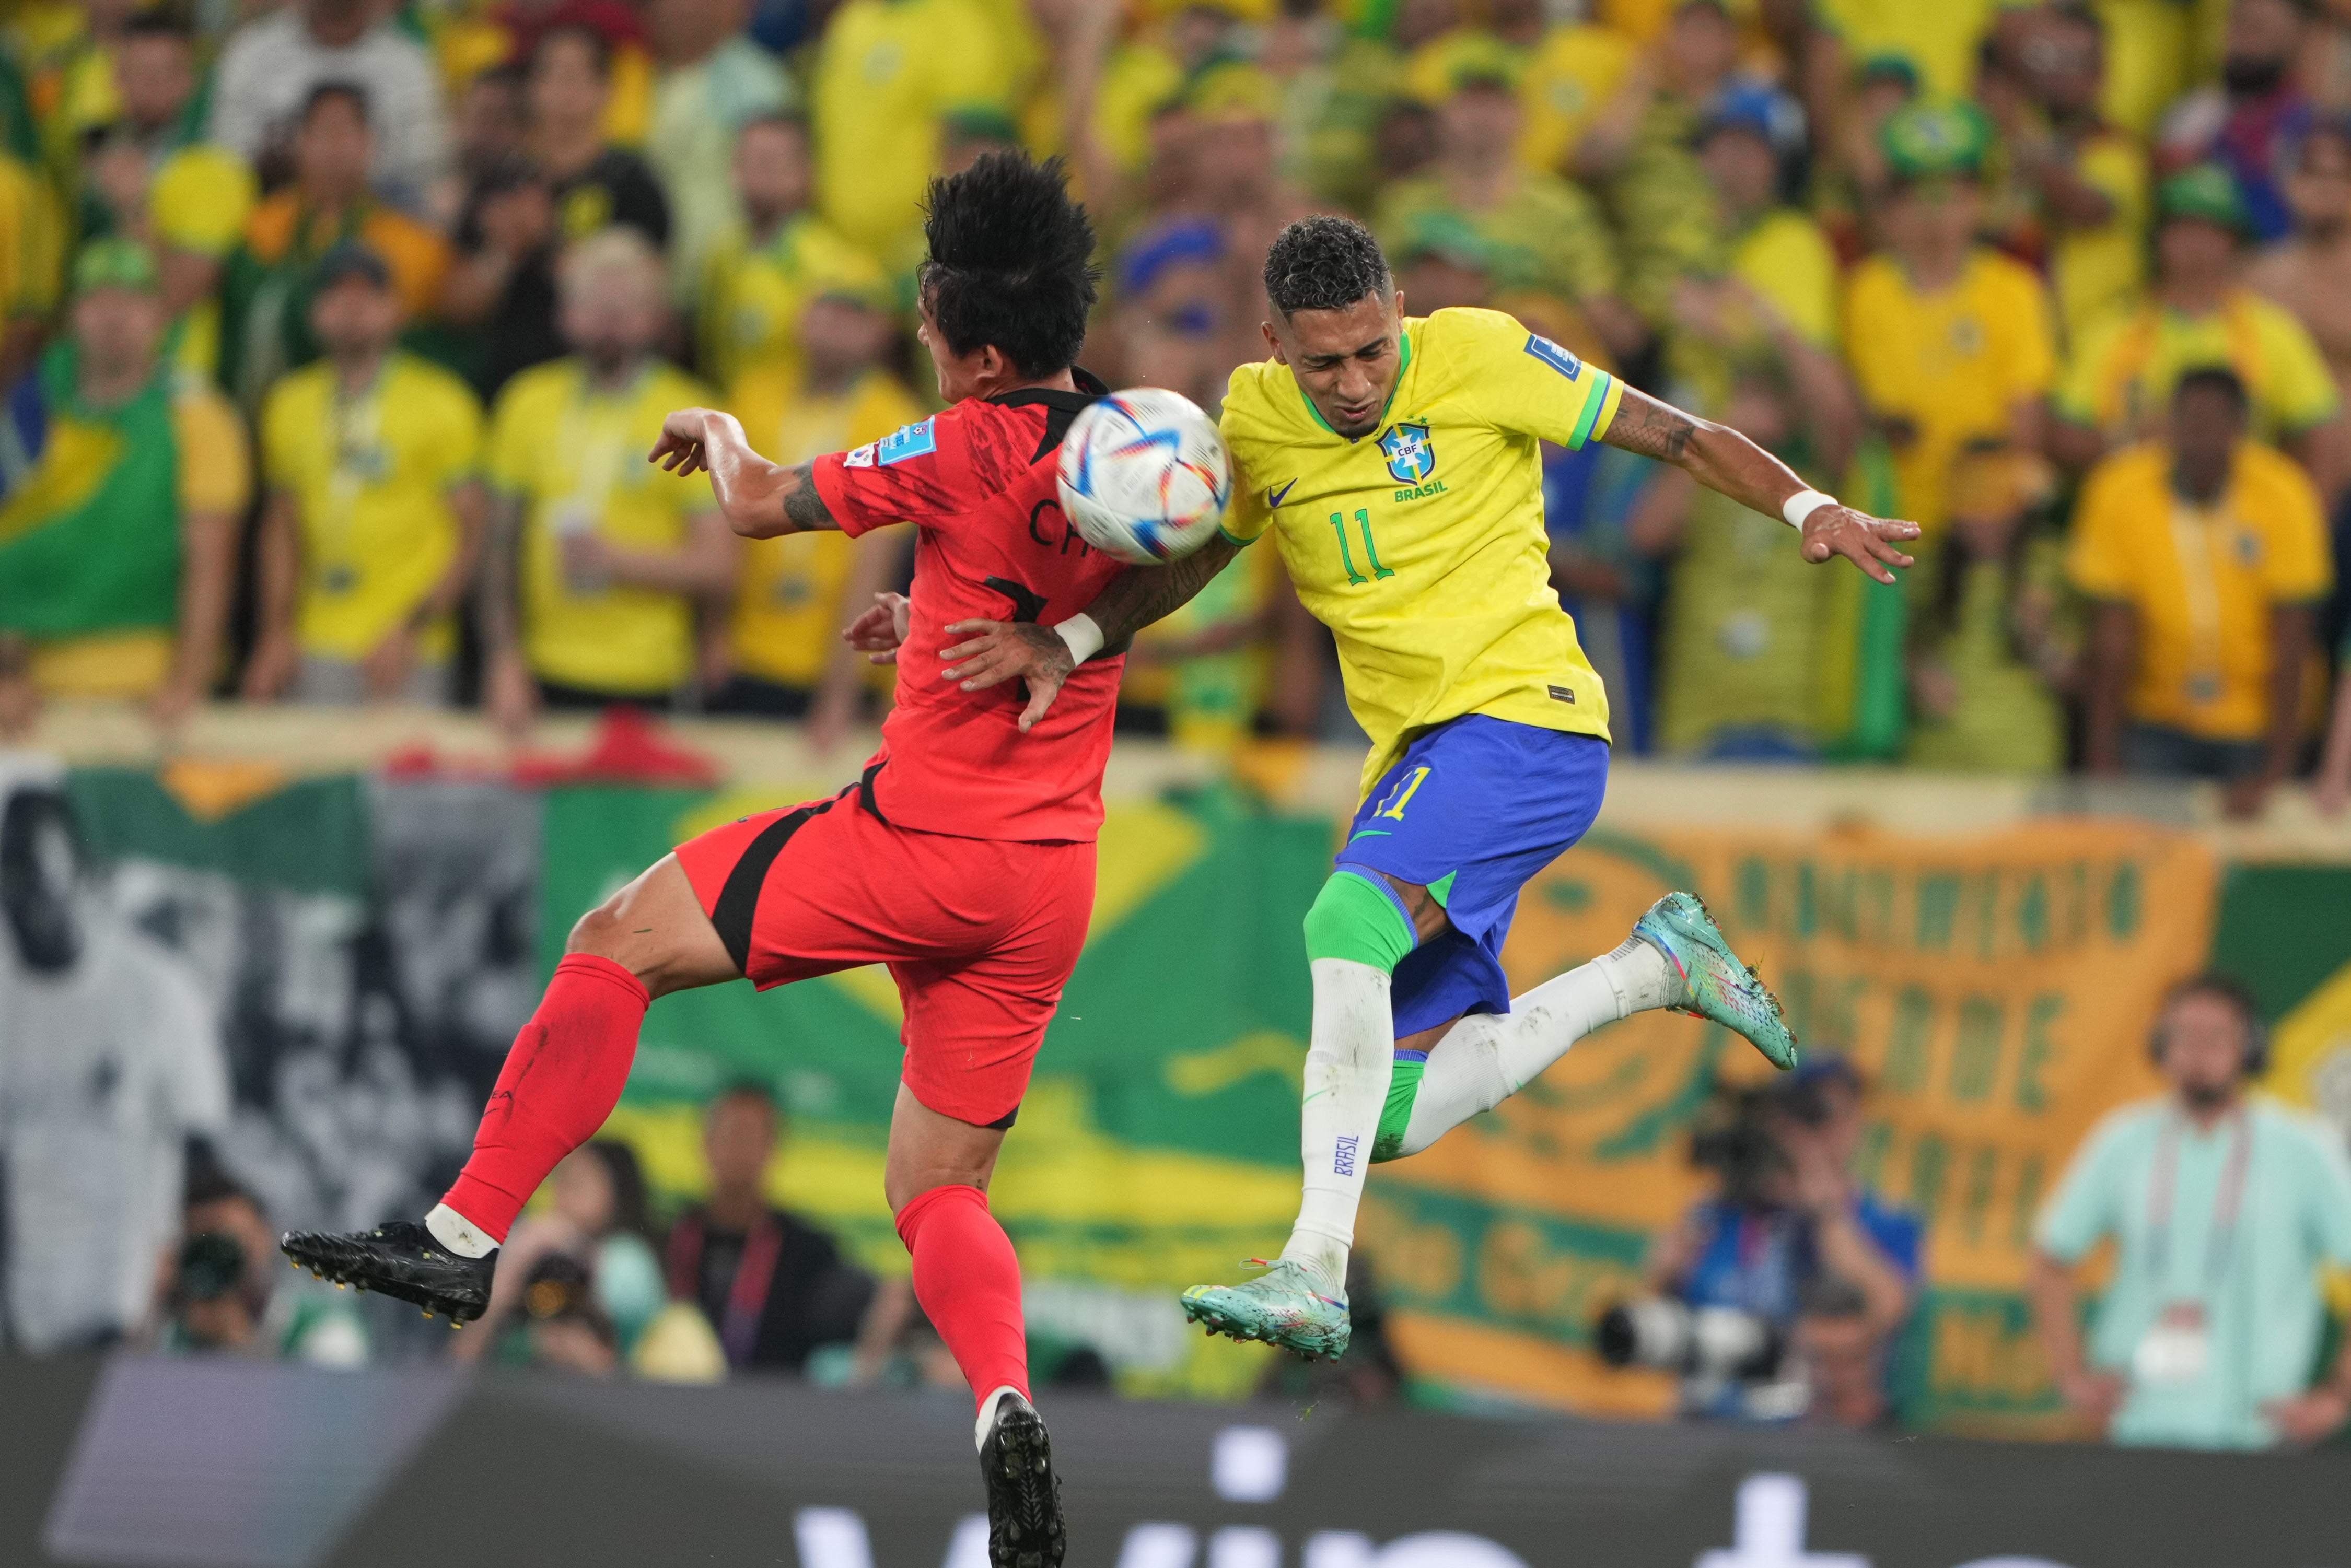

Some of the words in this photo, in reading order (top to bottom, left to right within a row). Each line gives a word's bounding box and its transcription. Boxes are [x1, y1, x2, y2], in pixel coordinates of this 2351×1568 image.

[1398, 444, 1417, 457] CBF
[1394, 481, 1448, 503] BRASIL
[1029, 499, 1095, 558] CH
[1330, 508, 1395, 587] 11
[1372, 766, 1432, 822] 1
[1334, 1135, 1359, 1177] BRASIL
